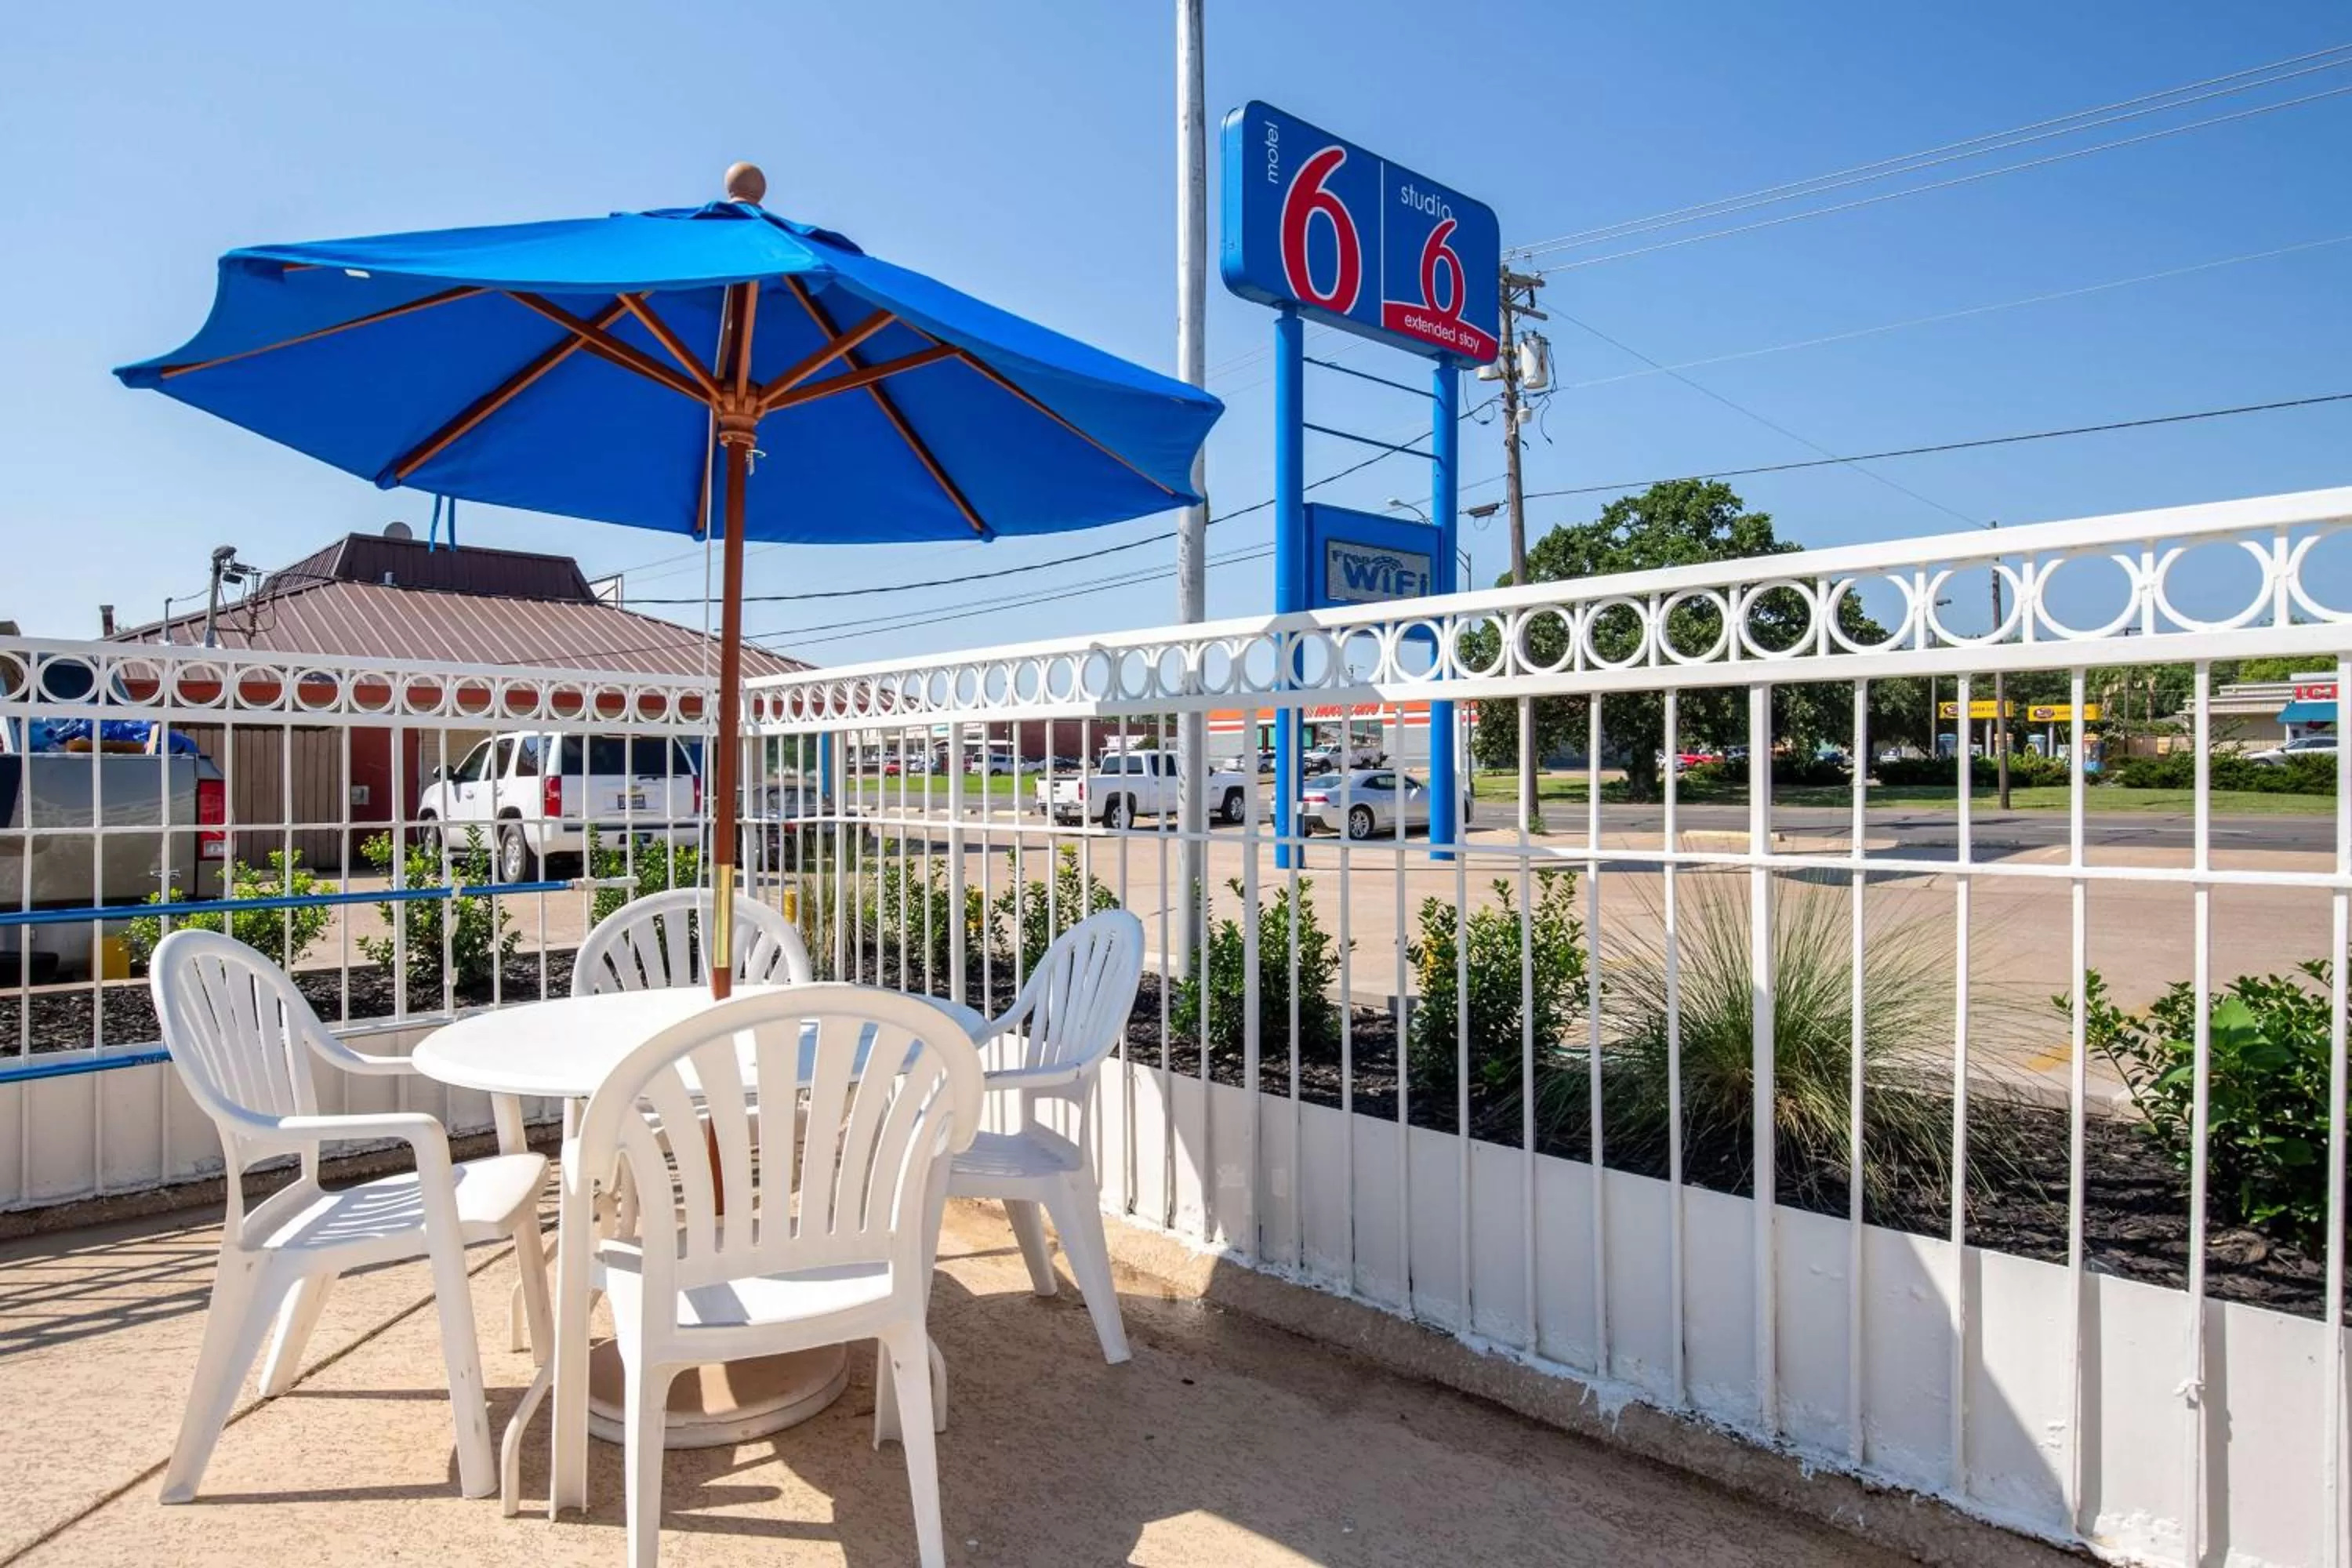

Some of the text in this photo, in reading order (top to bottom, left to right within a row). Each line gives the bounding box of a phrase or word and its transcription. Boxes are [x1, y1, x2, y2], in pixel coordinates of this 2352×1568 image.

[1264, 120, 1279, 184] motel
[1279, 144, 1363, 315] 6
[1400, 183, 1454, 220] studio
[1420, 219, 1465, 321] 6
[1404, 314, 1480, 354] extended stay
